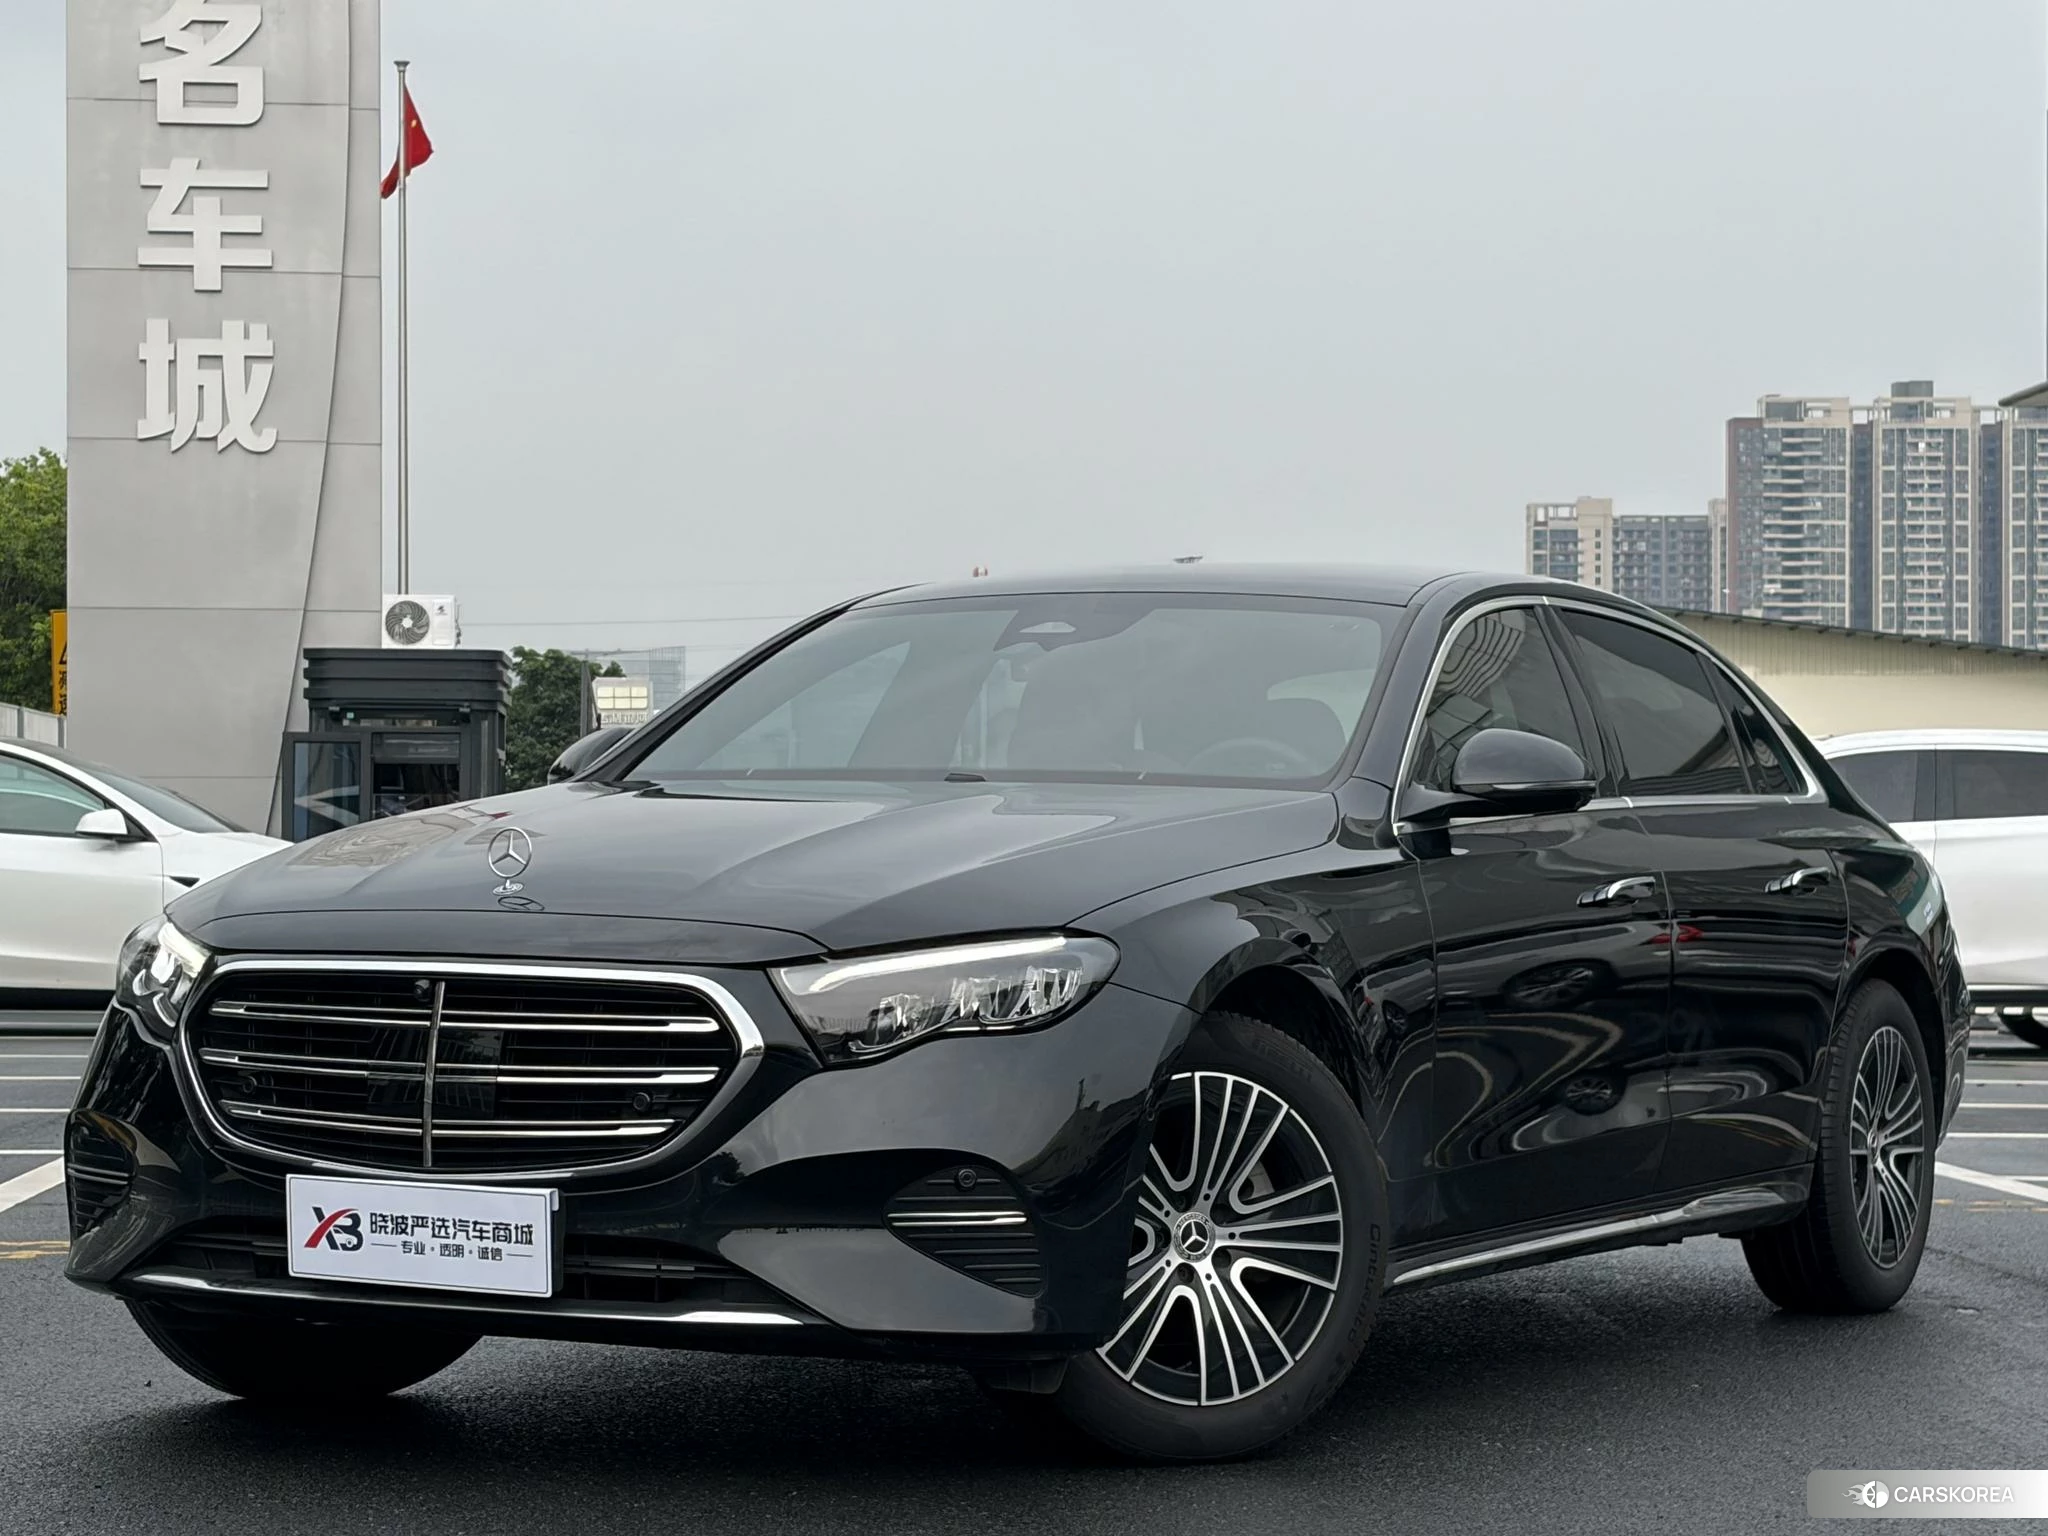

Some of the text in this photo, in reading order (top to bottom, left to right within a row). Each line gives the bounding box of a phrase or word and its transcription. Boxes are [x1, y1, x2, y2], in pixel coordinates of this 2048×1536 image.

[137, 0, 278, 453] 名车城
[369, 1211, 534, 1246] 晓波严选汽车商城
